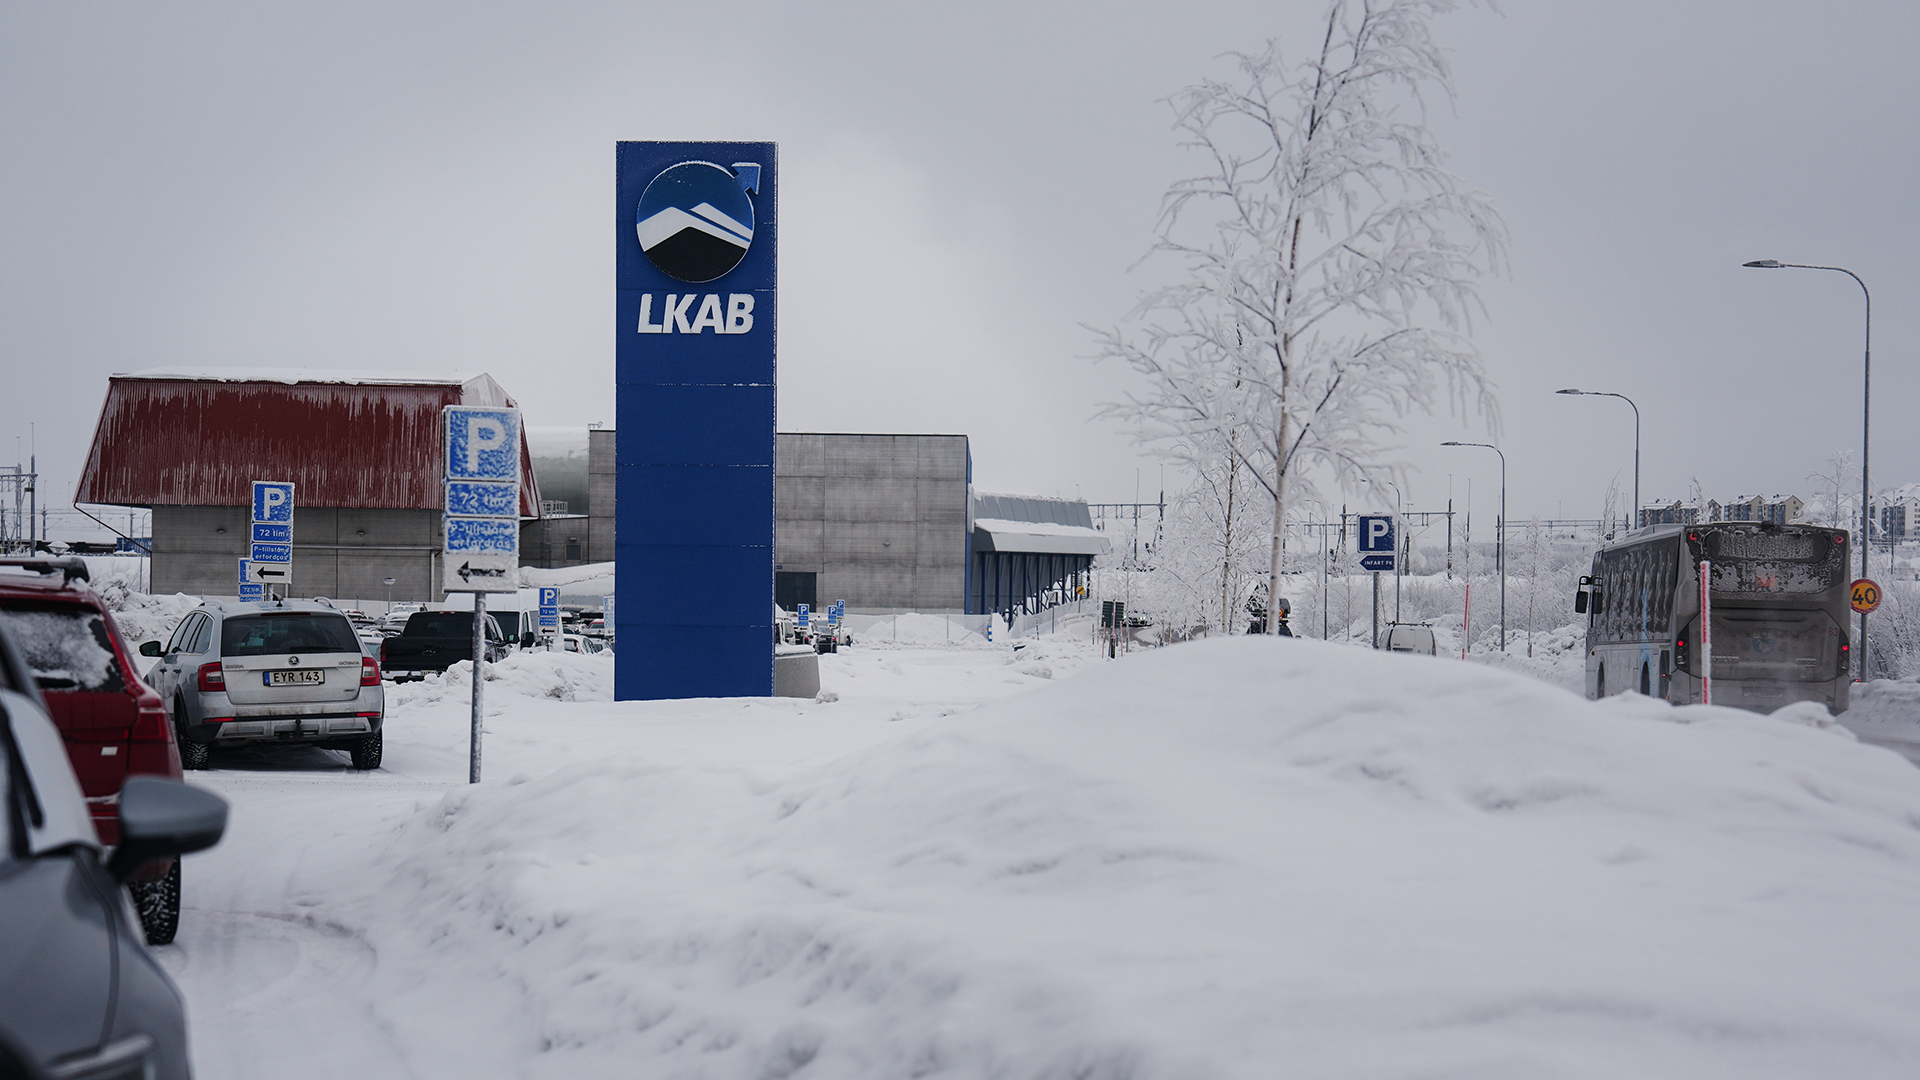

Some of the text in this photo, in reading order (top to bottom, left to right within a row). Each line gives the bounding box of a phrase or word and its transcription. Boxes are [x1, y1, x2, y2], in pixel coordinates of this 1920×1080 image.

[637, 293, 755, 334] LKAB
[468, 417, 505, 472] P
[264, 487, 285, 519] P
[461, 492, 478, 505] 72
[260, 529, 285, 537] 72 tim
[1368, 519, 1389, 548] P
[255, 553, 288, 561] erfordras
[543, 589, 555, 605] P
[1851, 587, 1877, 605] 40
[801, 606, 807, 614] P
[1828, 627, 1838, 637] 63
[273, 672, 320, 682] EYR 143
